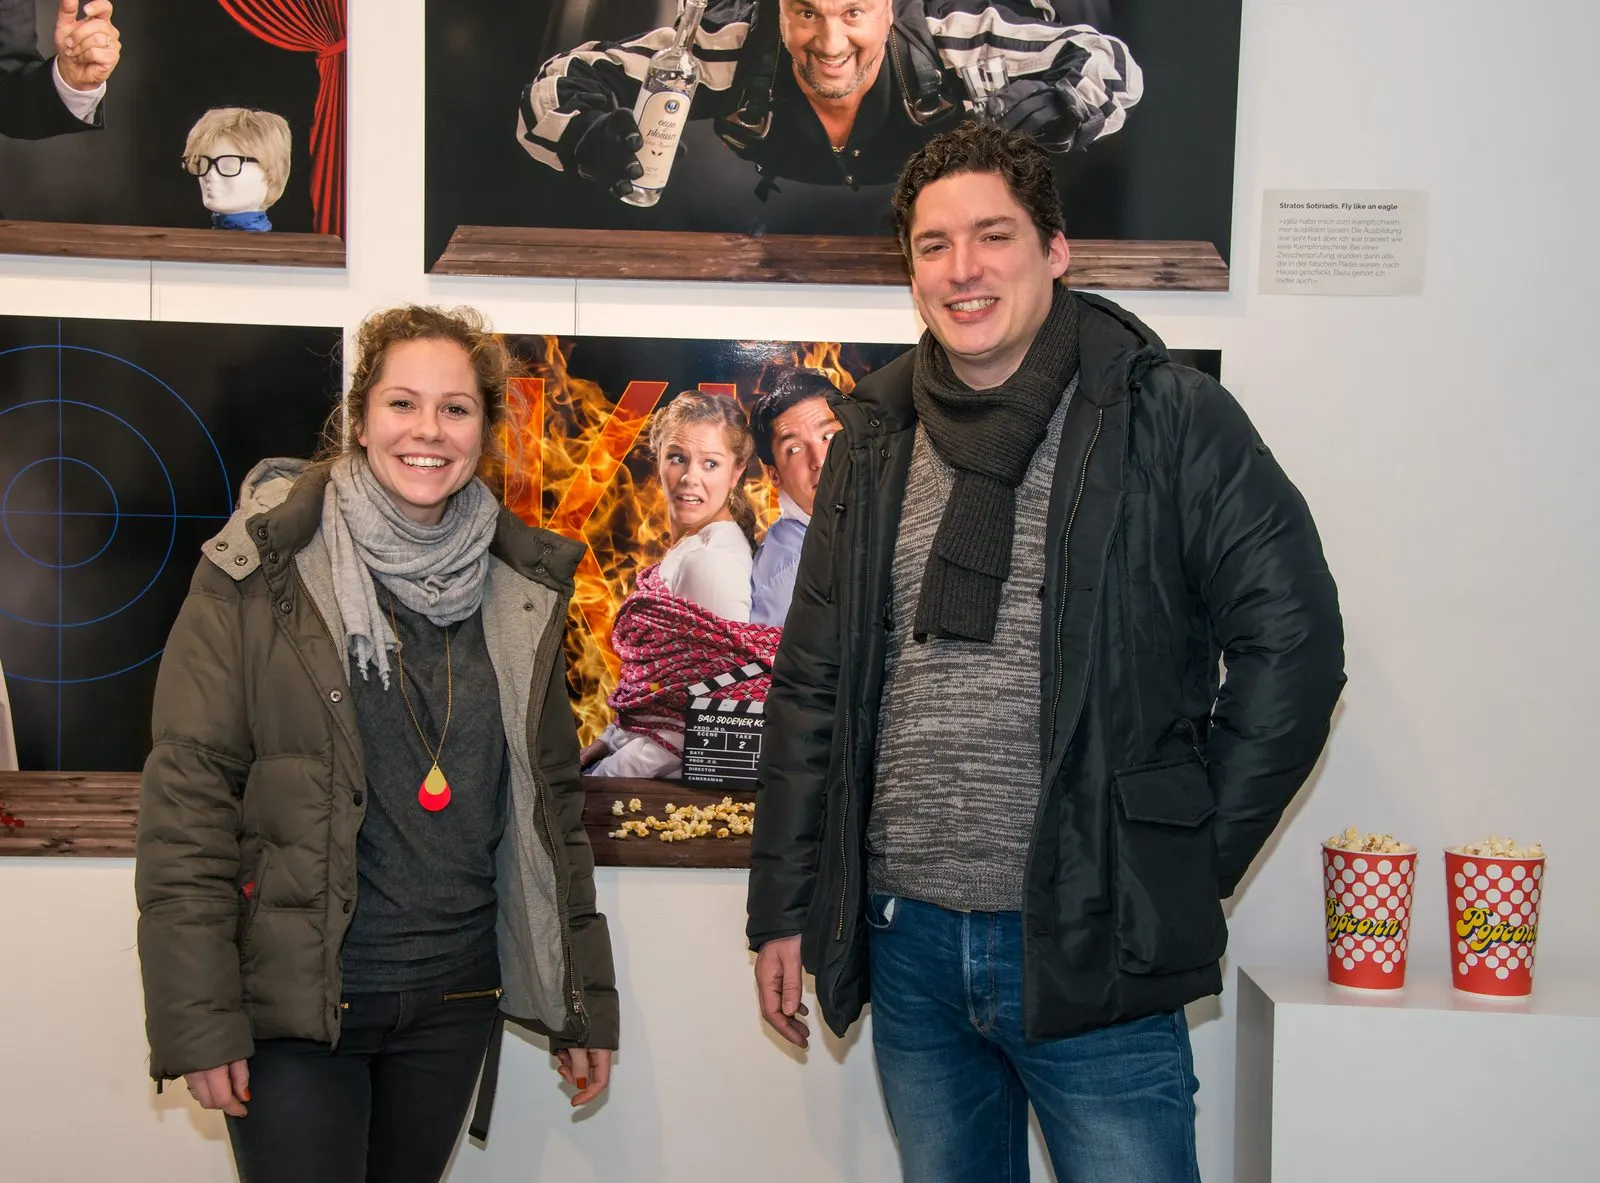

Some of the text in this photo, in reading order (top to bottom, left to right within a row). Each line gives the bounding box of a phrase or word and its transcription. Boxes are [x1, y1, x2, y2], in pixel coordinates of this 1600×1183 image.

[1341, 203, 1352, 211] Fly
[1377, 203, 1398, 211] eagle
[698, 714, 716, 723] BAD
[717, 715, 753, 728] SODENER
[703, 738, 710, 747] 7
[739, 741, 747, 750] 2
